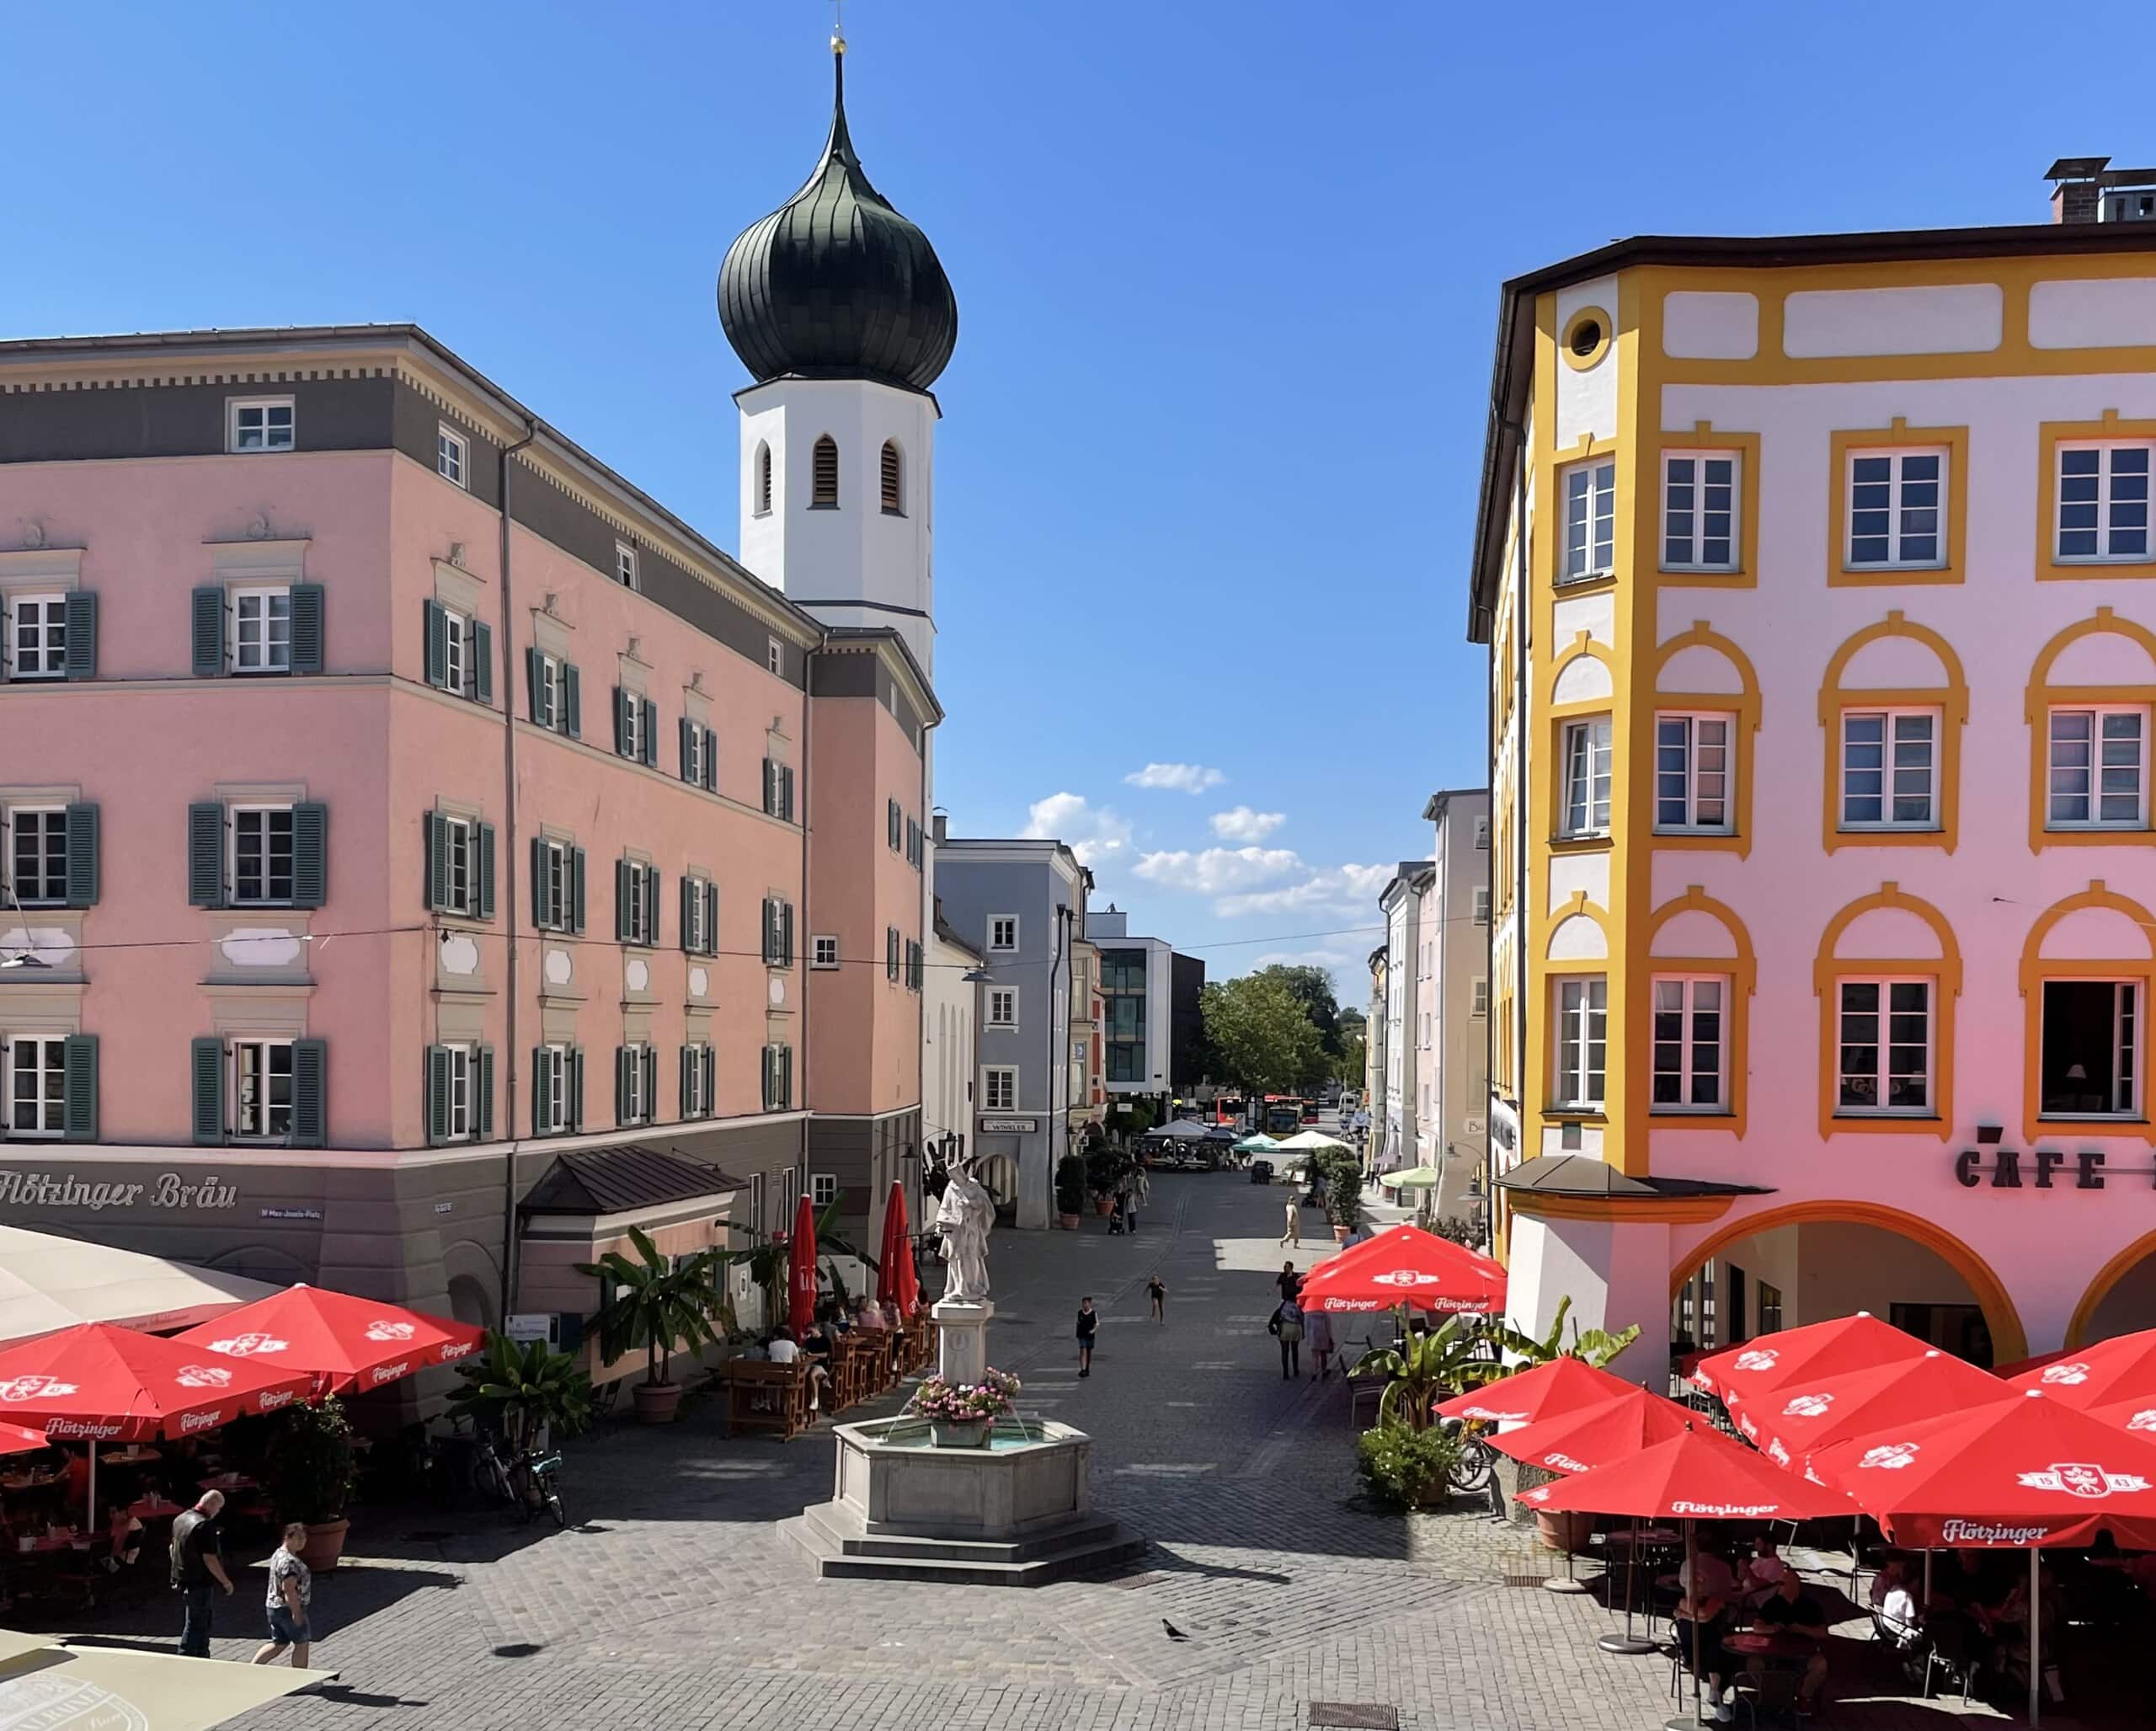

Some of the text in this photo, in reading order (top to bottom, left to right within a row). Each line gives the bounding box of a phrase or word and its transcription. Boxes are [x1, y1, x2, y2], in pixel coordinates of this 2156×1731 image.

[0, 1170, 237, 1210] Flötzinger Bräu
[1325, 1297, 1378, 1310] Flötzinger
[1434, 1297, 1489, 1310] Flötzinger
[372, 1362, 408, 1383] Flötzinger
[259, 1391, 293, 1408] Flötzinger
[45, 1418, 122, 1439] Flötzinger
[181, 1411, 221, 1432] Flötzinger
[1544, 1453, 1598, 1472] Flötz
[2038, 1477, 2053, 1486] 15
[2114, 1478, 2130, 1488] 43
[1672, 1501, 1779, 1516] Flötzinger
[1942, 1520, 2048, 1545] Flötzinger
